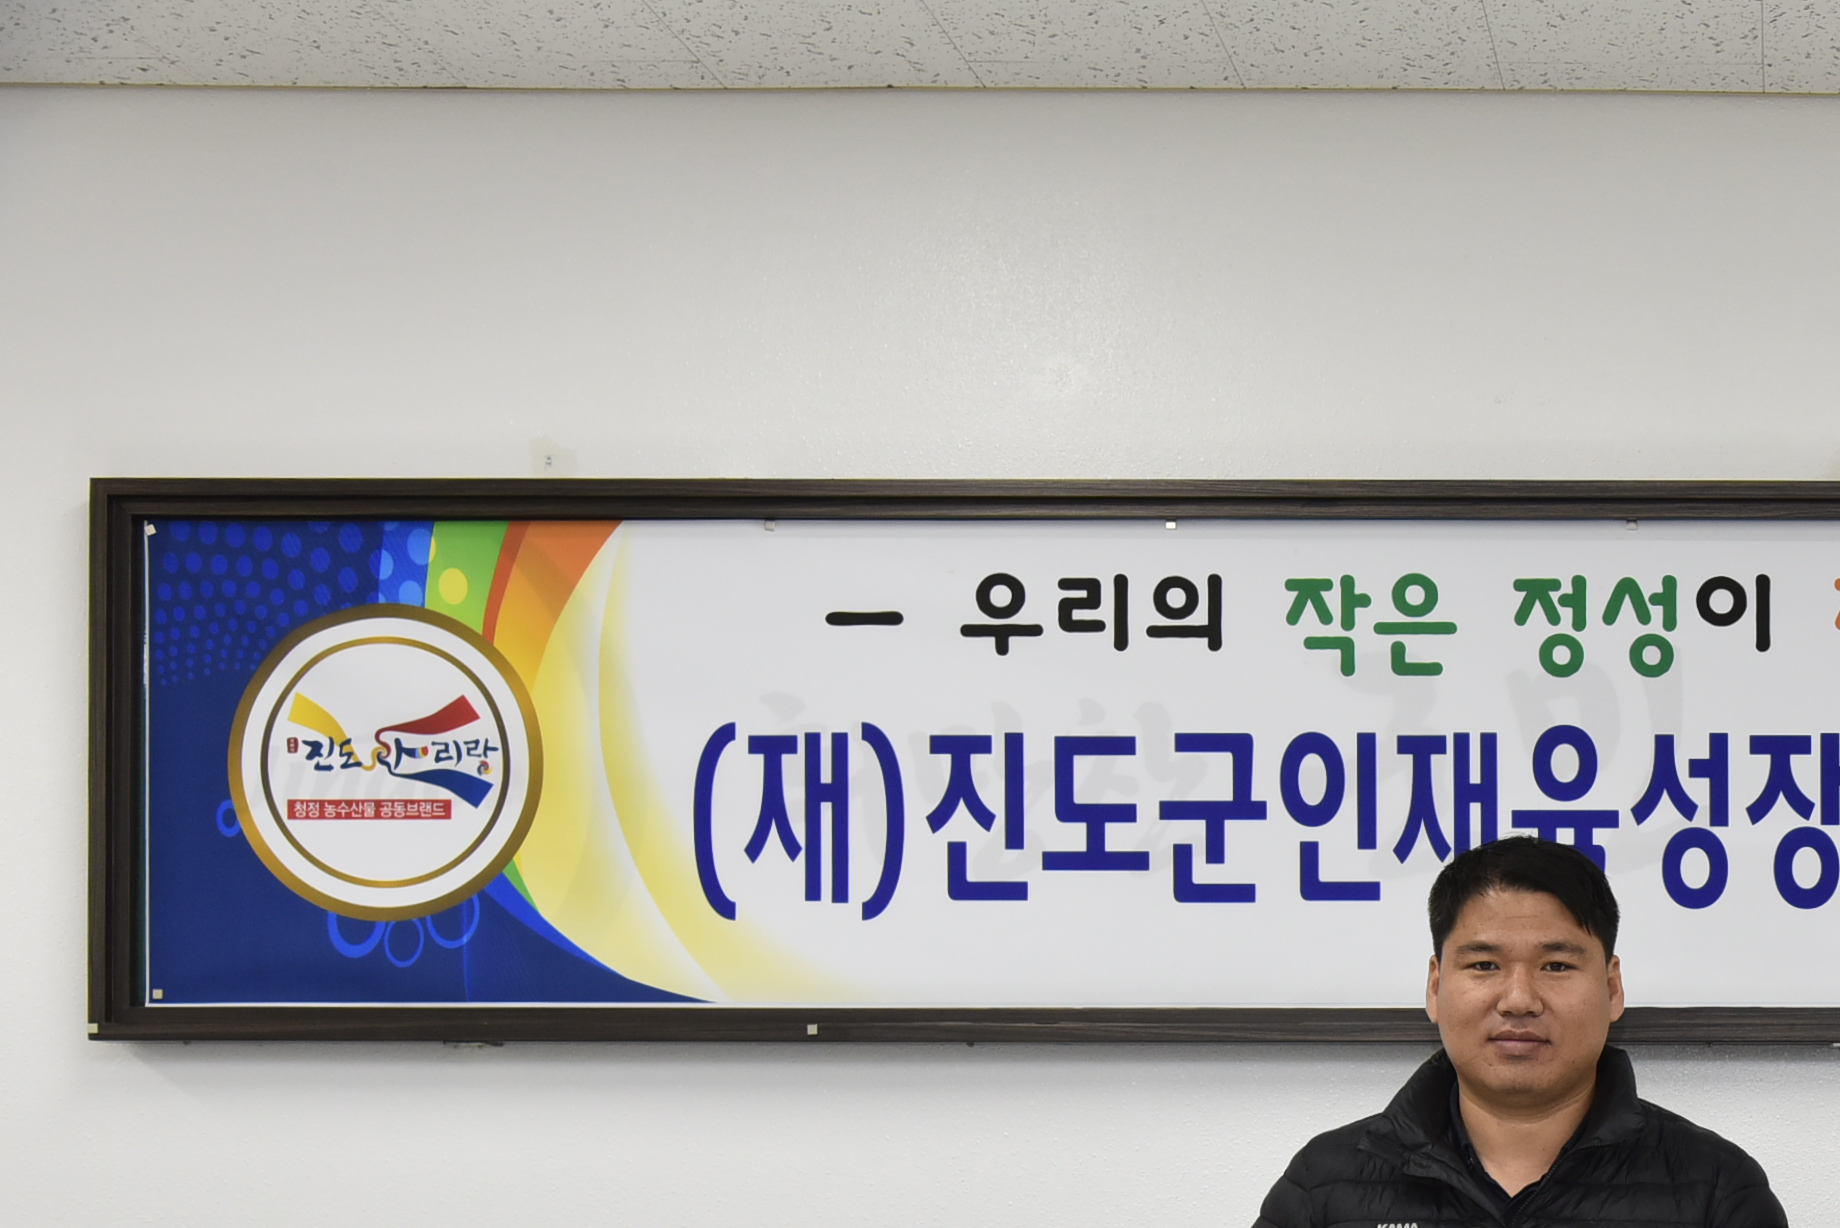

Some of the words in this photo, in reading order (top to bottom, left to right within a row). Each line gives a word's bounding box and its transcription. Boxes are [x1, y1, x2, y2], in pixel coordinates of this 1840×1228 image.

[960, 573, 1224, 657] 우리의
[1285, 573, 1459, 678] 작은
[1513, 574, 1772, 679] 정성이
[293, 801, 320, 818] 청정
[323, 801, 376, 818] 농수산물
[379, 801, 446, 818] 공동브랜드
